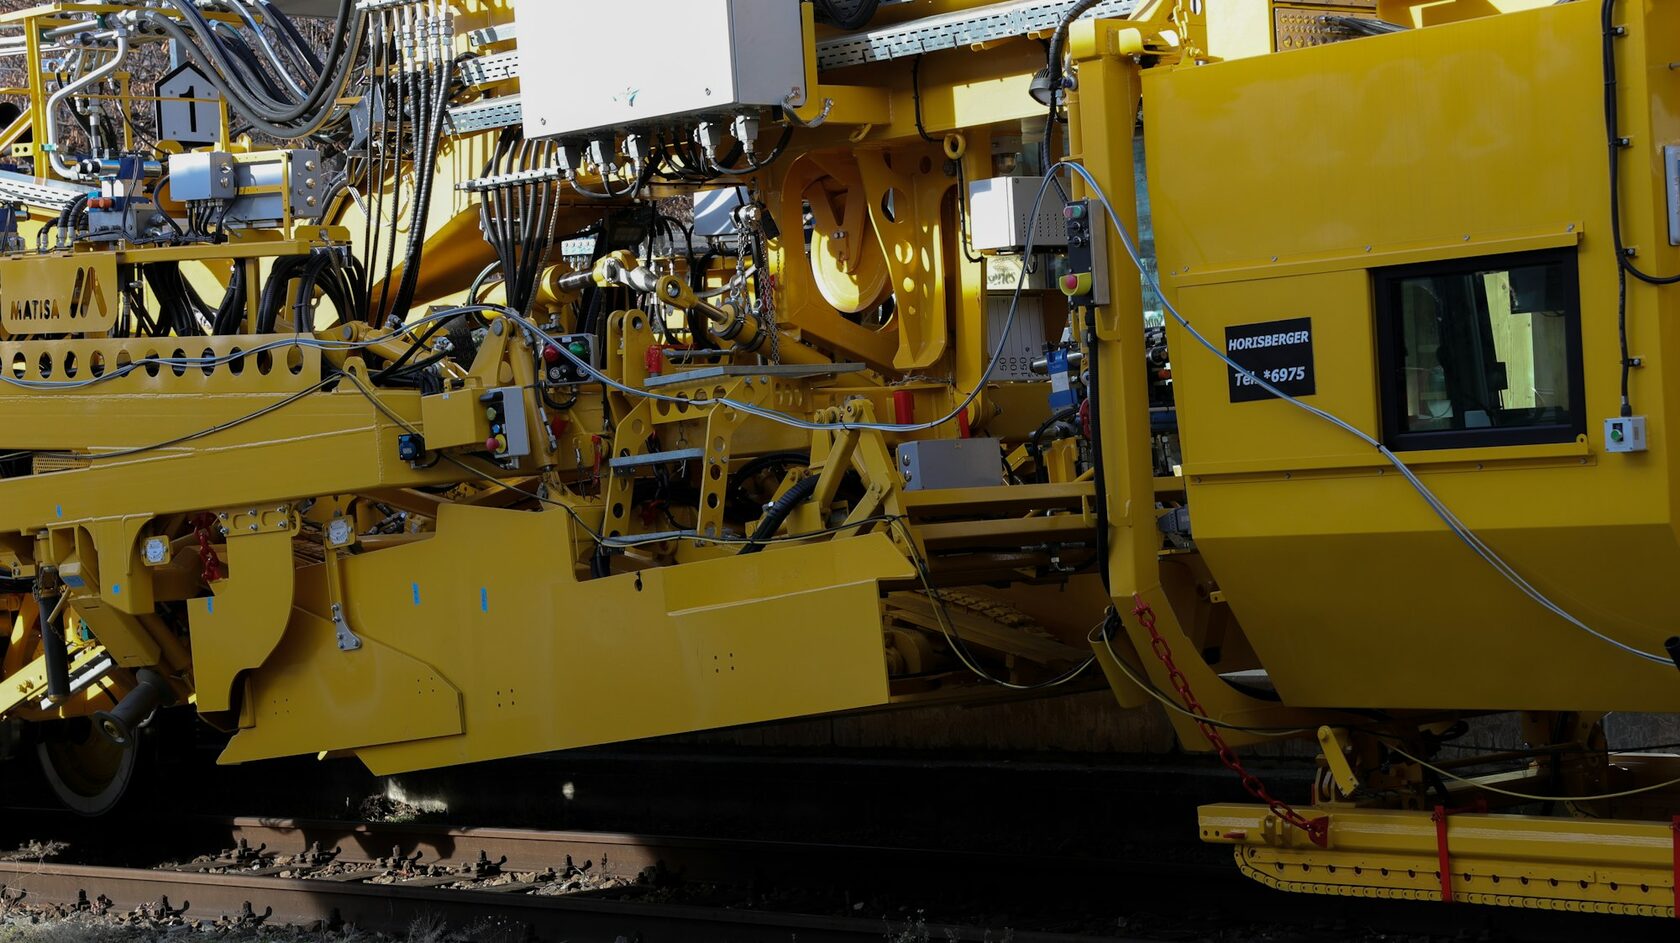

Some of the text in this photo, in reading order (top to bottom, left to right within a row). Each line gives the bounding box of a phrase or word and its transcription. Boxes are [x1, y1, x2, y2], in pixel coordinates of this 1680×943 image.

[179, 85, 197, 132] 1
[10, 299, 60, 321] MATISA
[1228, 330, 1309, 351] HORISBERGER
[999, 357, 1007, 371] 50
[1009, 357, 1017, 377] 100
[1019, 357, 1028, 377] 150
